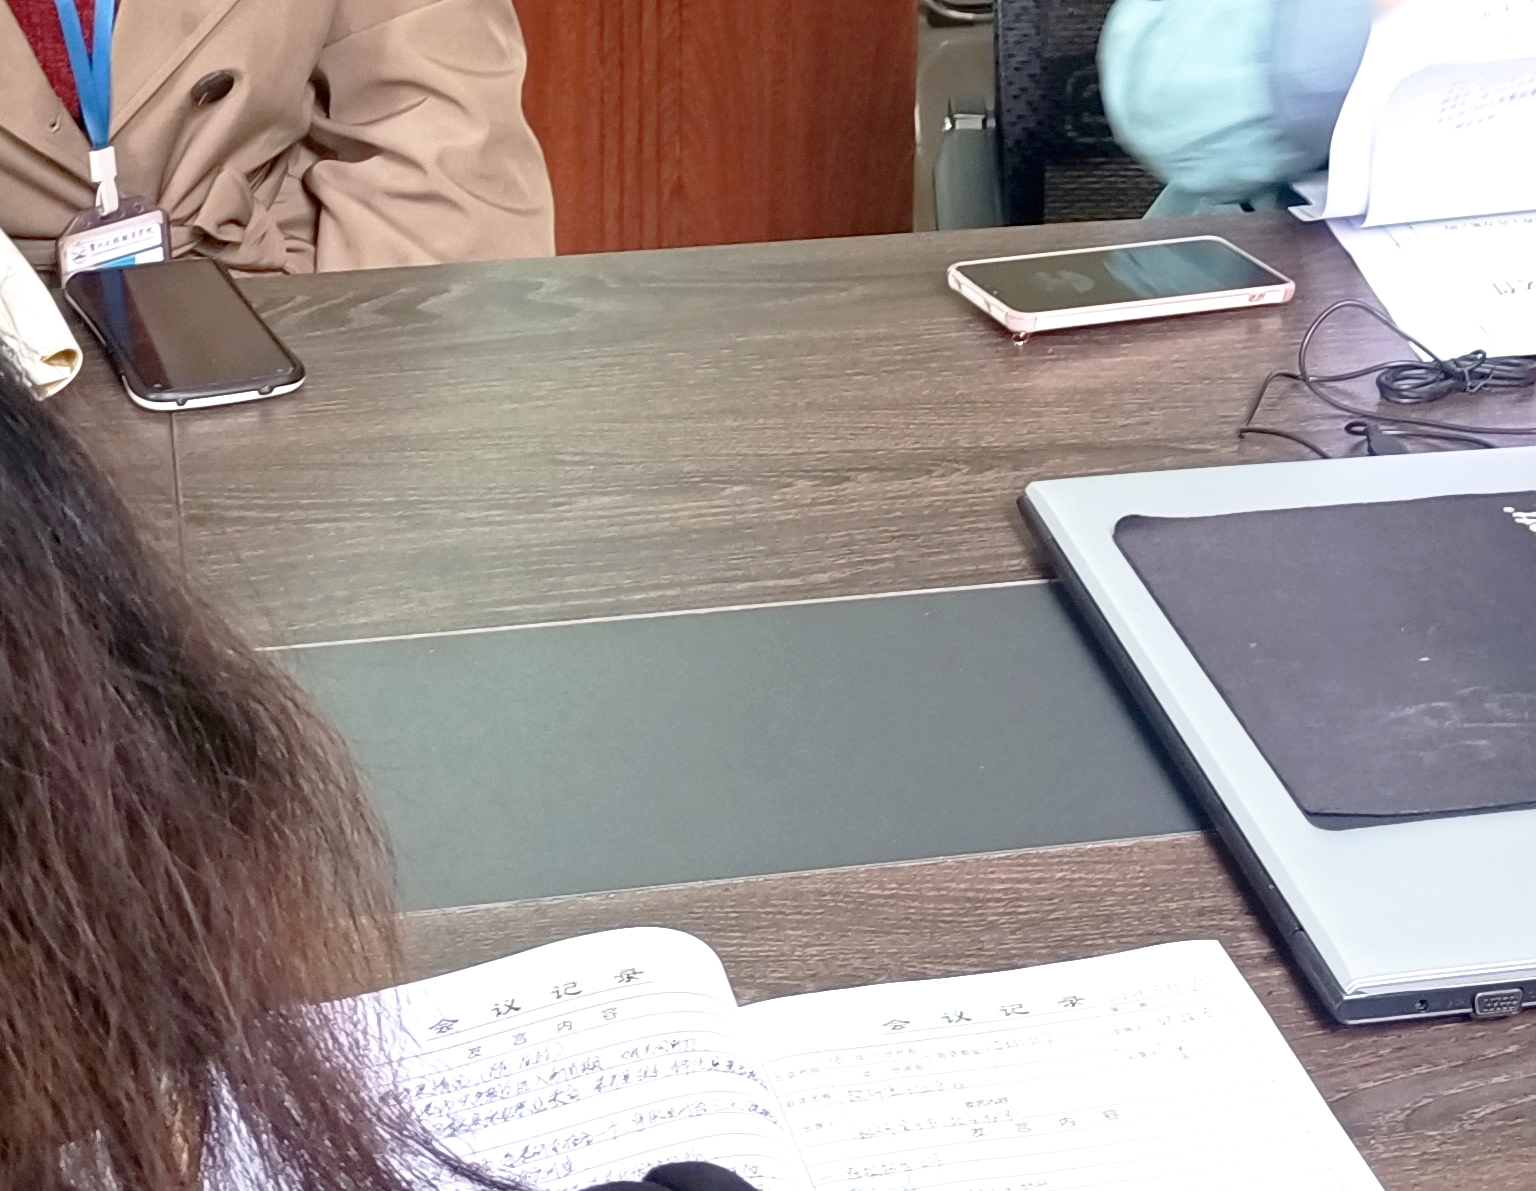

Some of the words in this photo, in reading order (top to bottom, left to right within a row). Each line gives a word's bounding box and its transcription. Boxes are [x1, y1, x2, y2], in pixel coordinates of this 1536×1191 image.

[428, 967, 644, 1035] 会议记录
[883, 993, 1086, 1033] 会议记录
